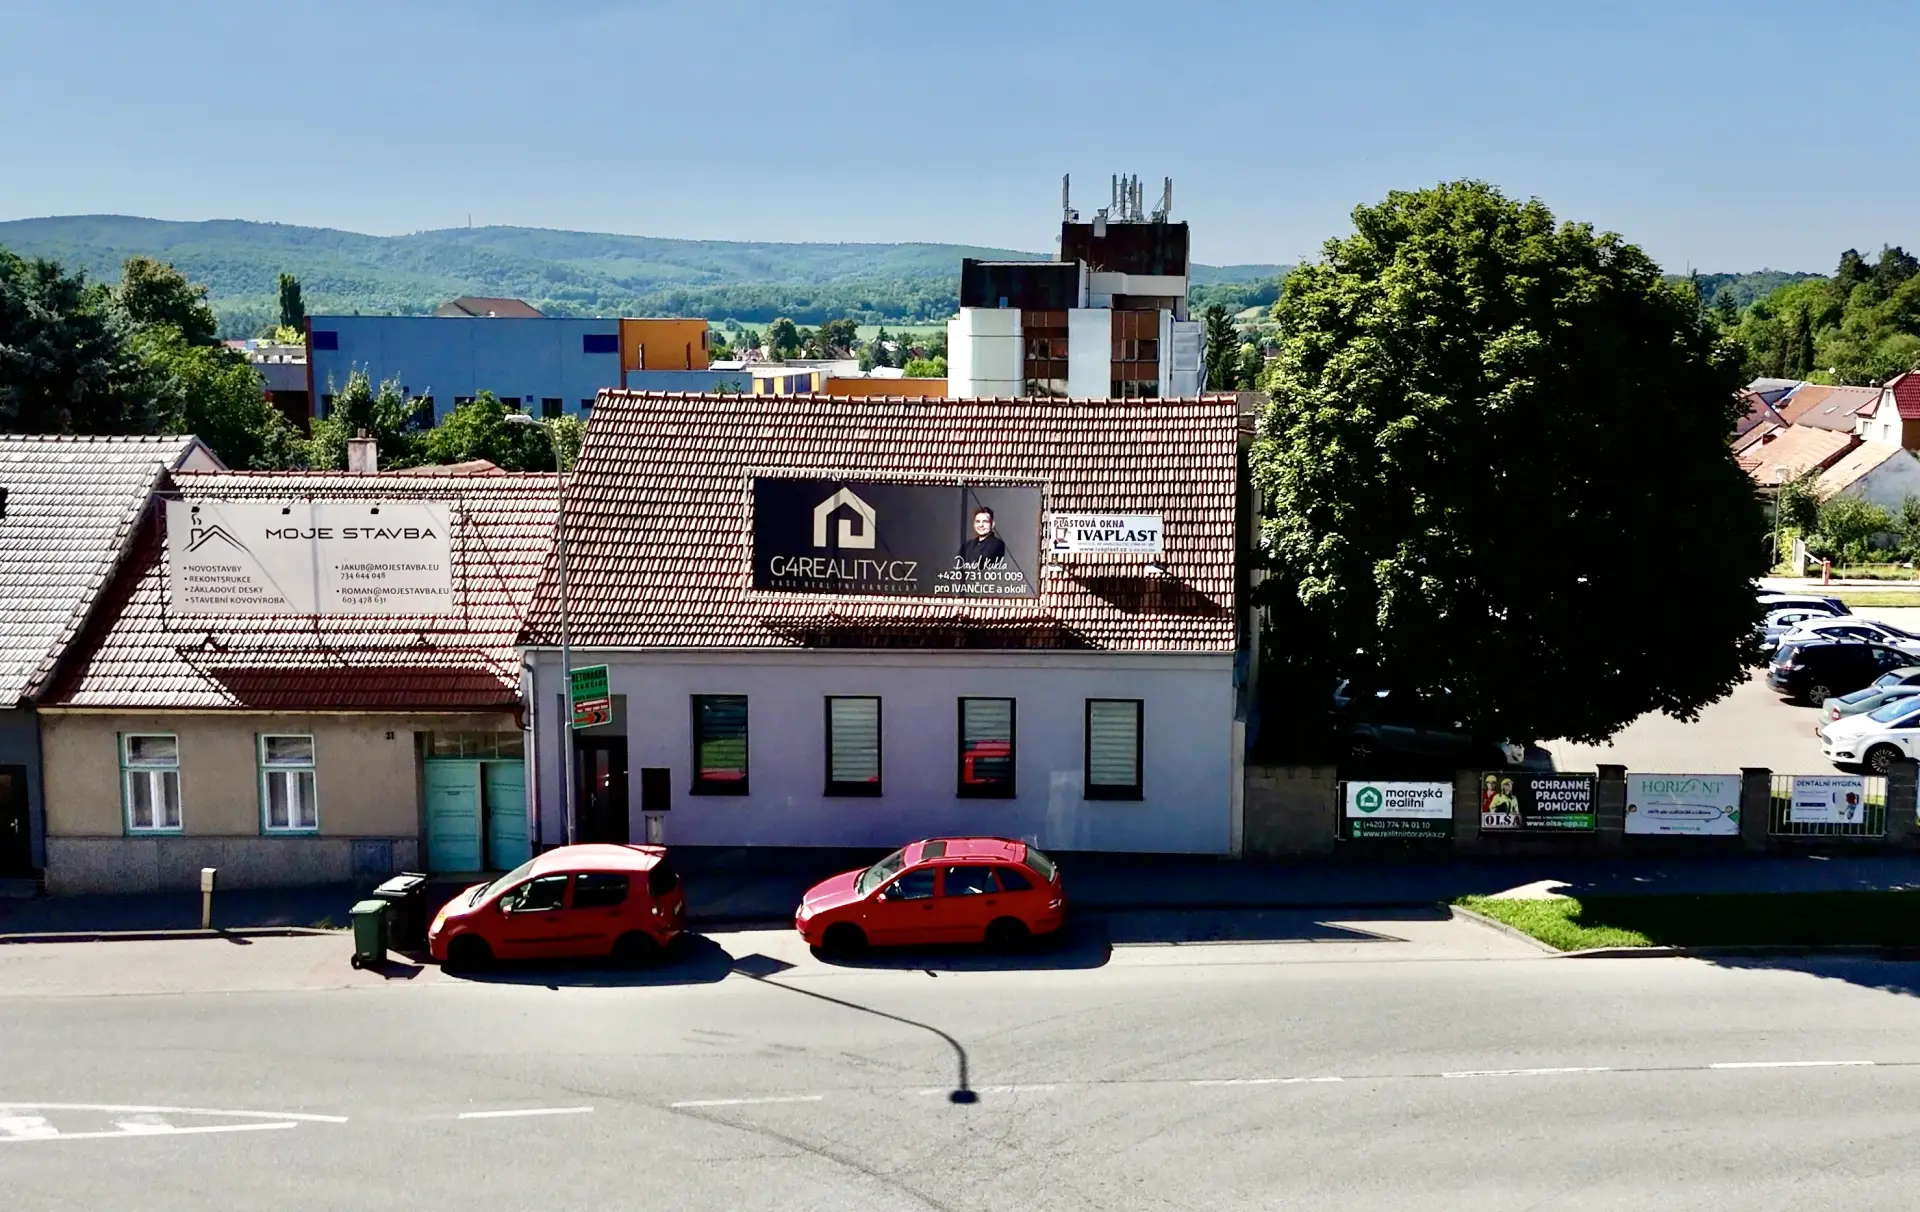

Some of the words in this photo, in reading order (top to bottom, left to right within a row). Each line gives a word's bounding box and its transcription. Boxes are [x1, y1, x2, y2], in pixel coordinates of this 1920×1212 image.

[1100, 519, 1125, 528] OKNA
[266, 528, 333, 539] MOJE
[343, 528, 437, 539] STAVBA
[1077, 529, 1157, 542] IVAPLAST
[340, 564, 439, 572] JAKUB@MOJESTAVBA.EU
[770, 555, 918, 582] G4REALITY.CZ
[937, 571, 962, 580] +420
[965, 571, 981, 580] 731
[984, 571, 1002, 580] 001
[1004, 572, 1024, 581] 009
[190, 585, 236, 594] ZÁKLADOVÉ
[238, 586, 264, 594] DESKY
[341, 587, 450, 596] ROMAN@MOJESTAVBA.EU
[934, 585, 950, 594] pro
[951, 582, 995, 594] IVANČICE
[996, 586, 1003, 594] a
[1004, 584, 1027, 594] okolí
[190, 596, 228, 604] STAVEBNÍ
[230, 596, 285, 604] KOVOVÝROBA
[342, 597, 357, 605] 603
[1530, 778, 1591, 790] OCHRANNÉ
[1385, 788, 1443, 798] moravská
[1535, 789, 1590, 801] PRACOVNÍ
[1385, 797, 1424, 808] realitní
[1537, 800, 1590, 812] POMŮCKY
[1363, 821, 1385, 829] (+420)
[1485, 815, 1521, 826] OLSA
[1526, 820, 1588, 828] www.olsa-opp.cz
